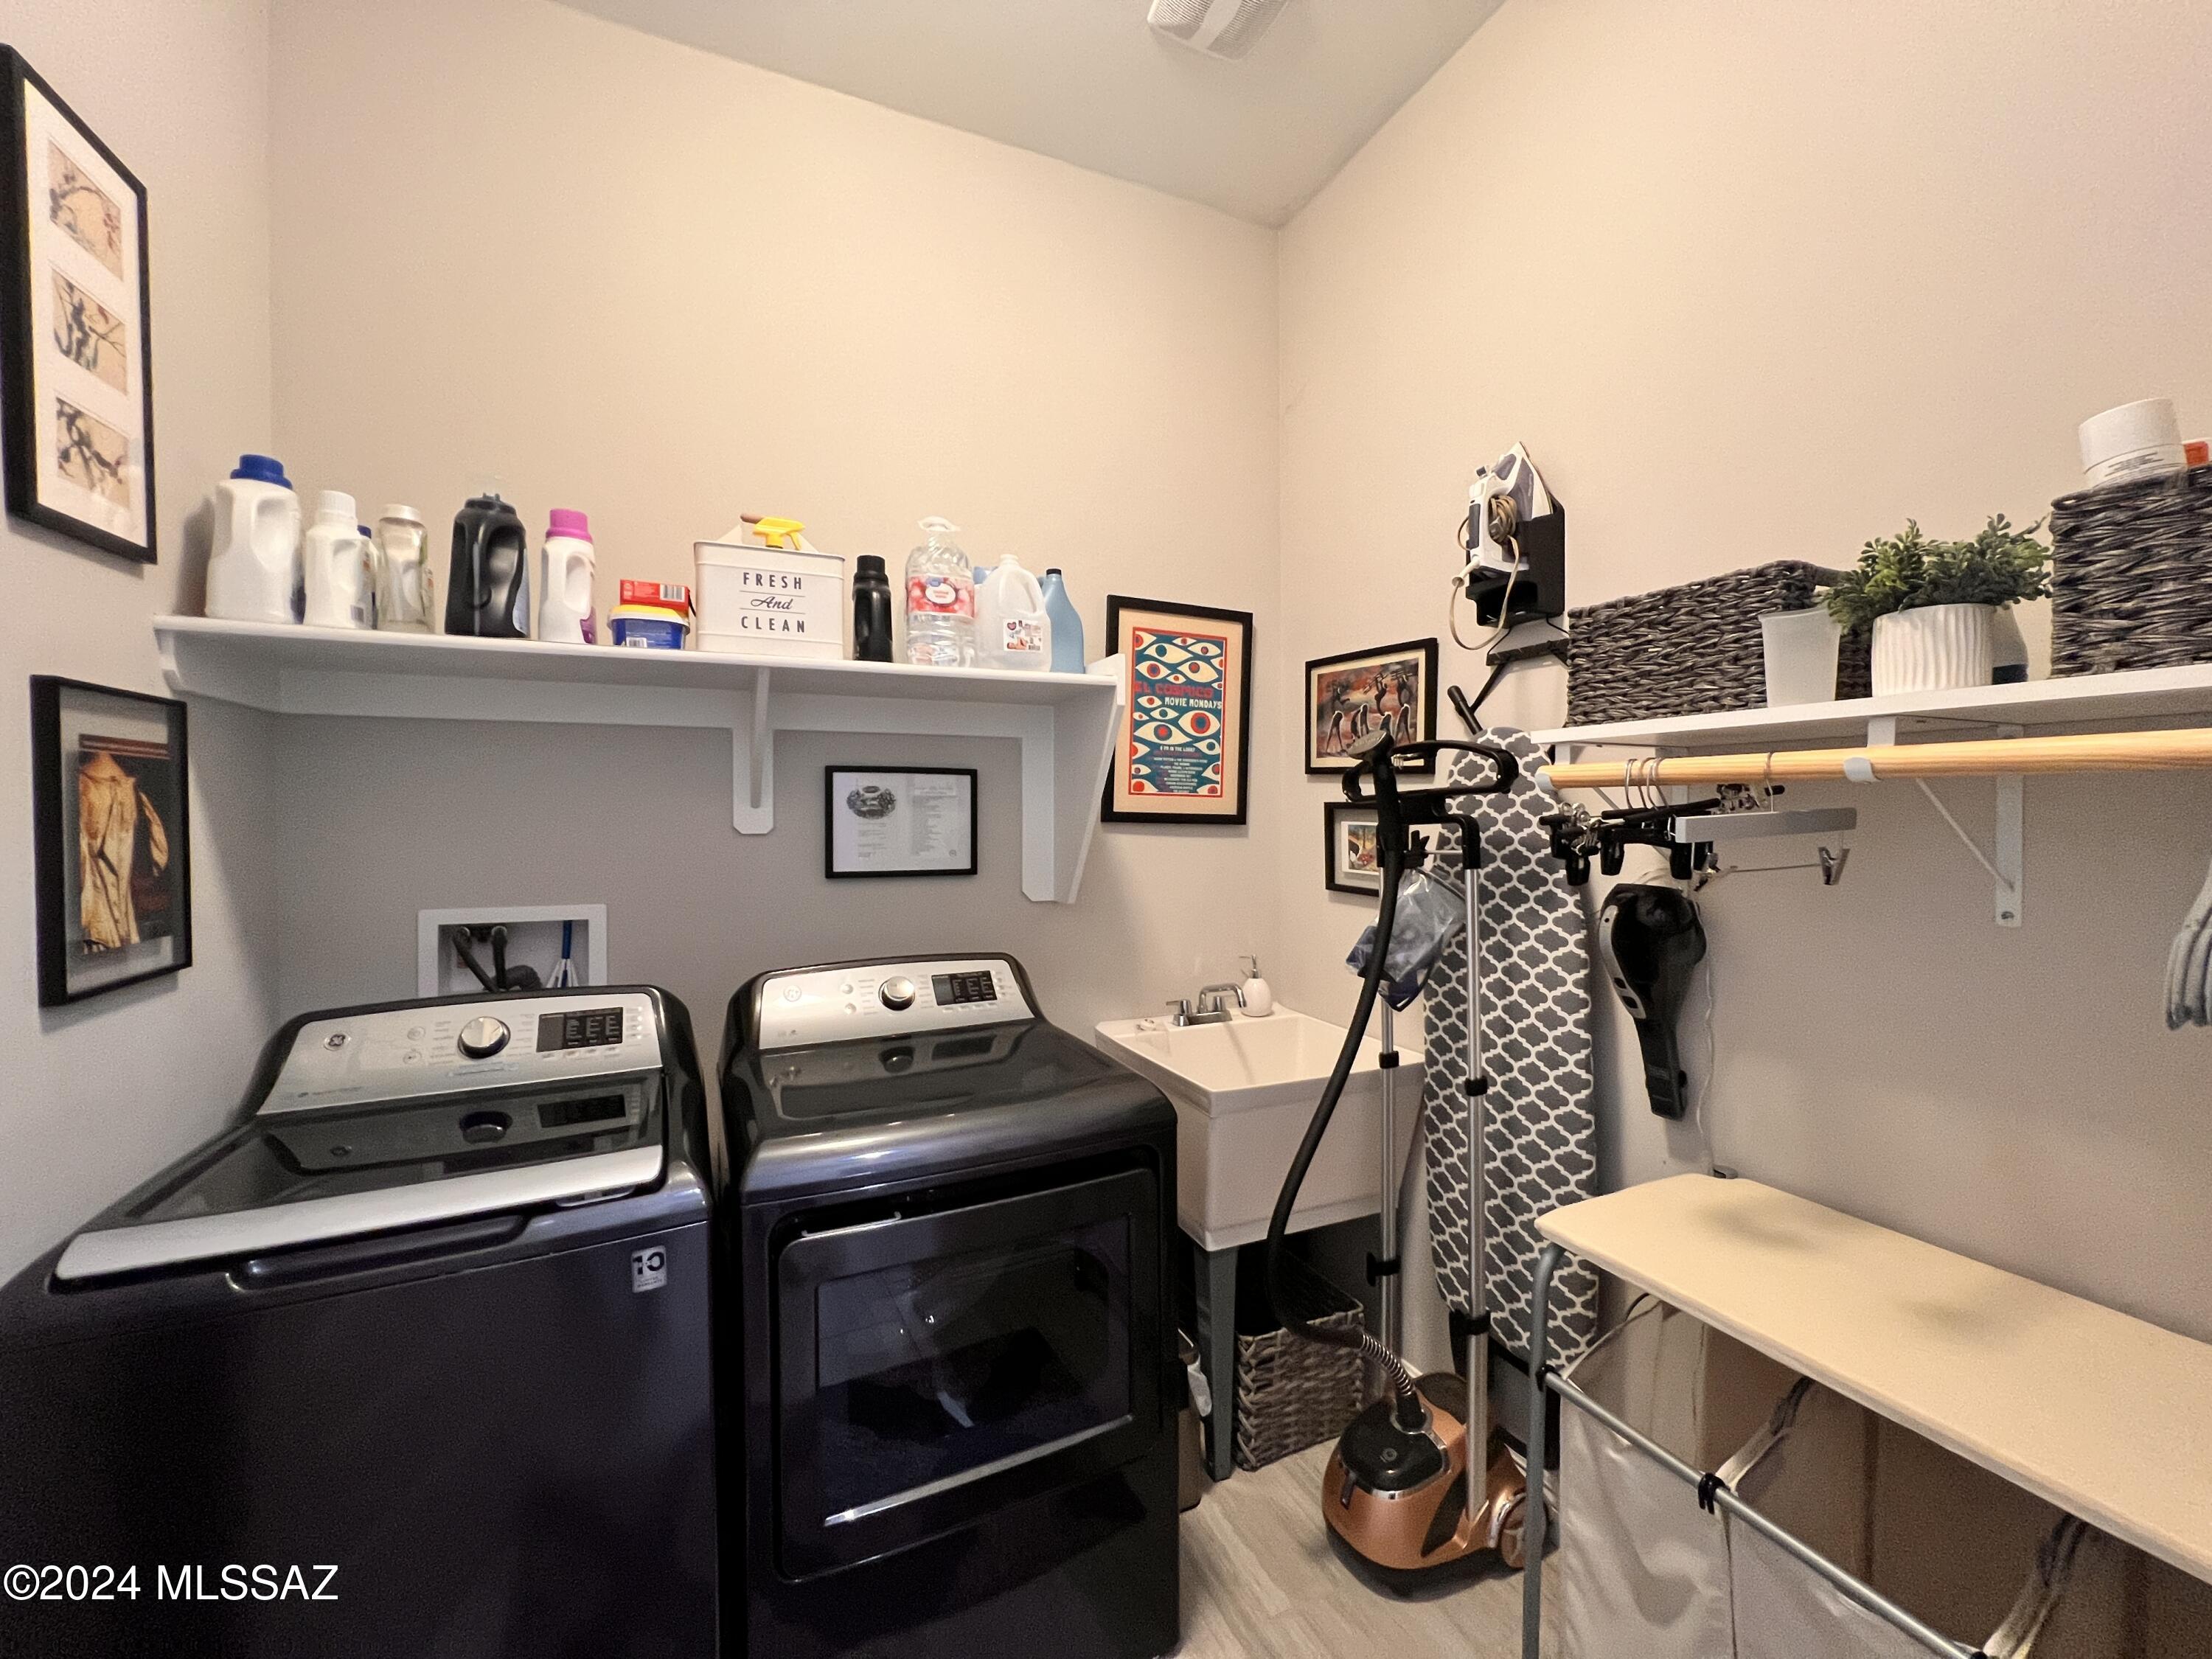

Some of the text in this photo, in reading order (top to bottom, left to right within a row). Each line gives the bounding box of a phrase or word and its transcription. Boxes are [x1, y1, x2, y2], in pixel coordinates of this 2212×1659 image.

[743, 572, 801, 589] FRESH
[751, 596, 793, 610] And
[741, 616, 804, 633] CLEAN
[1164, 697, 1222, 709] MOVIE MONDAYS
